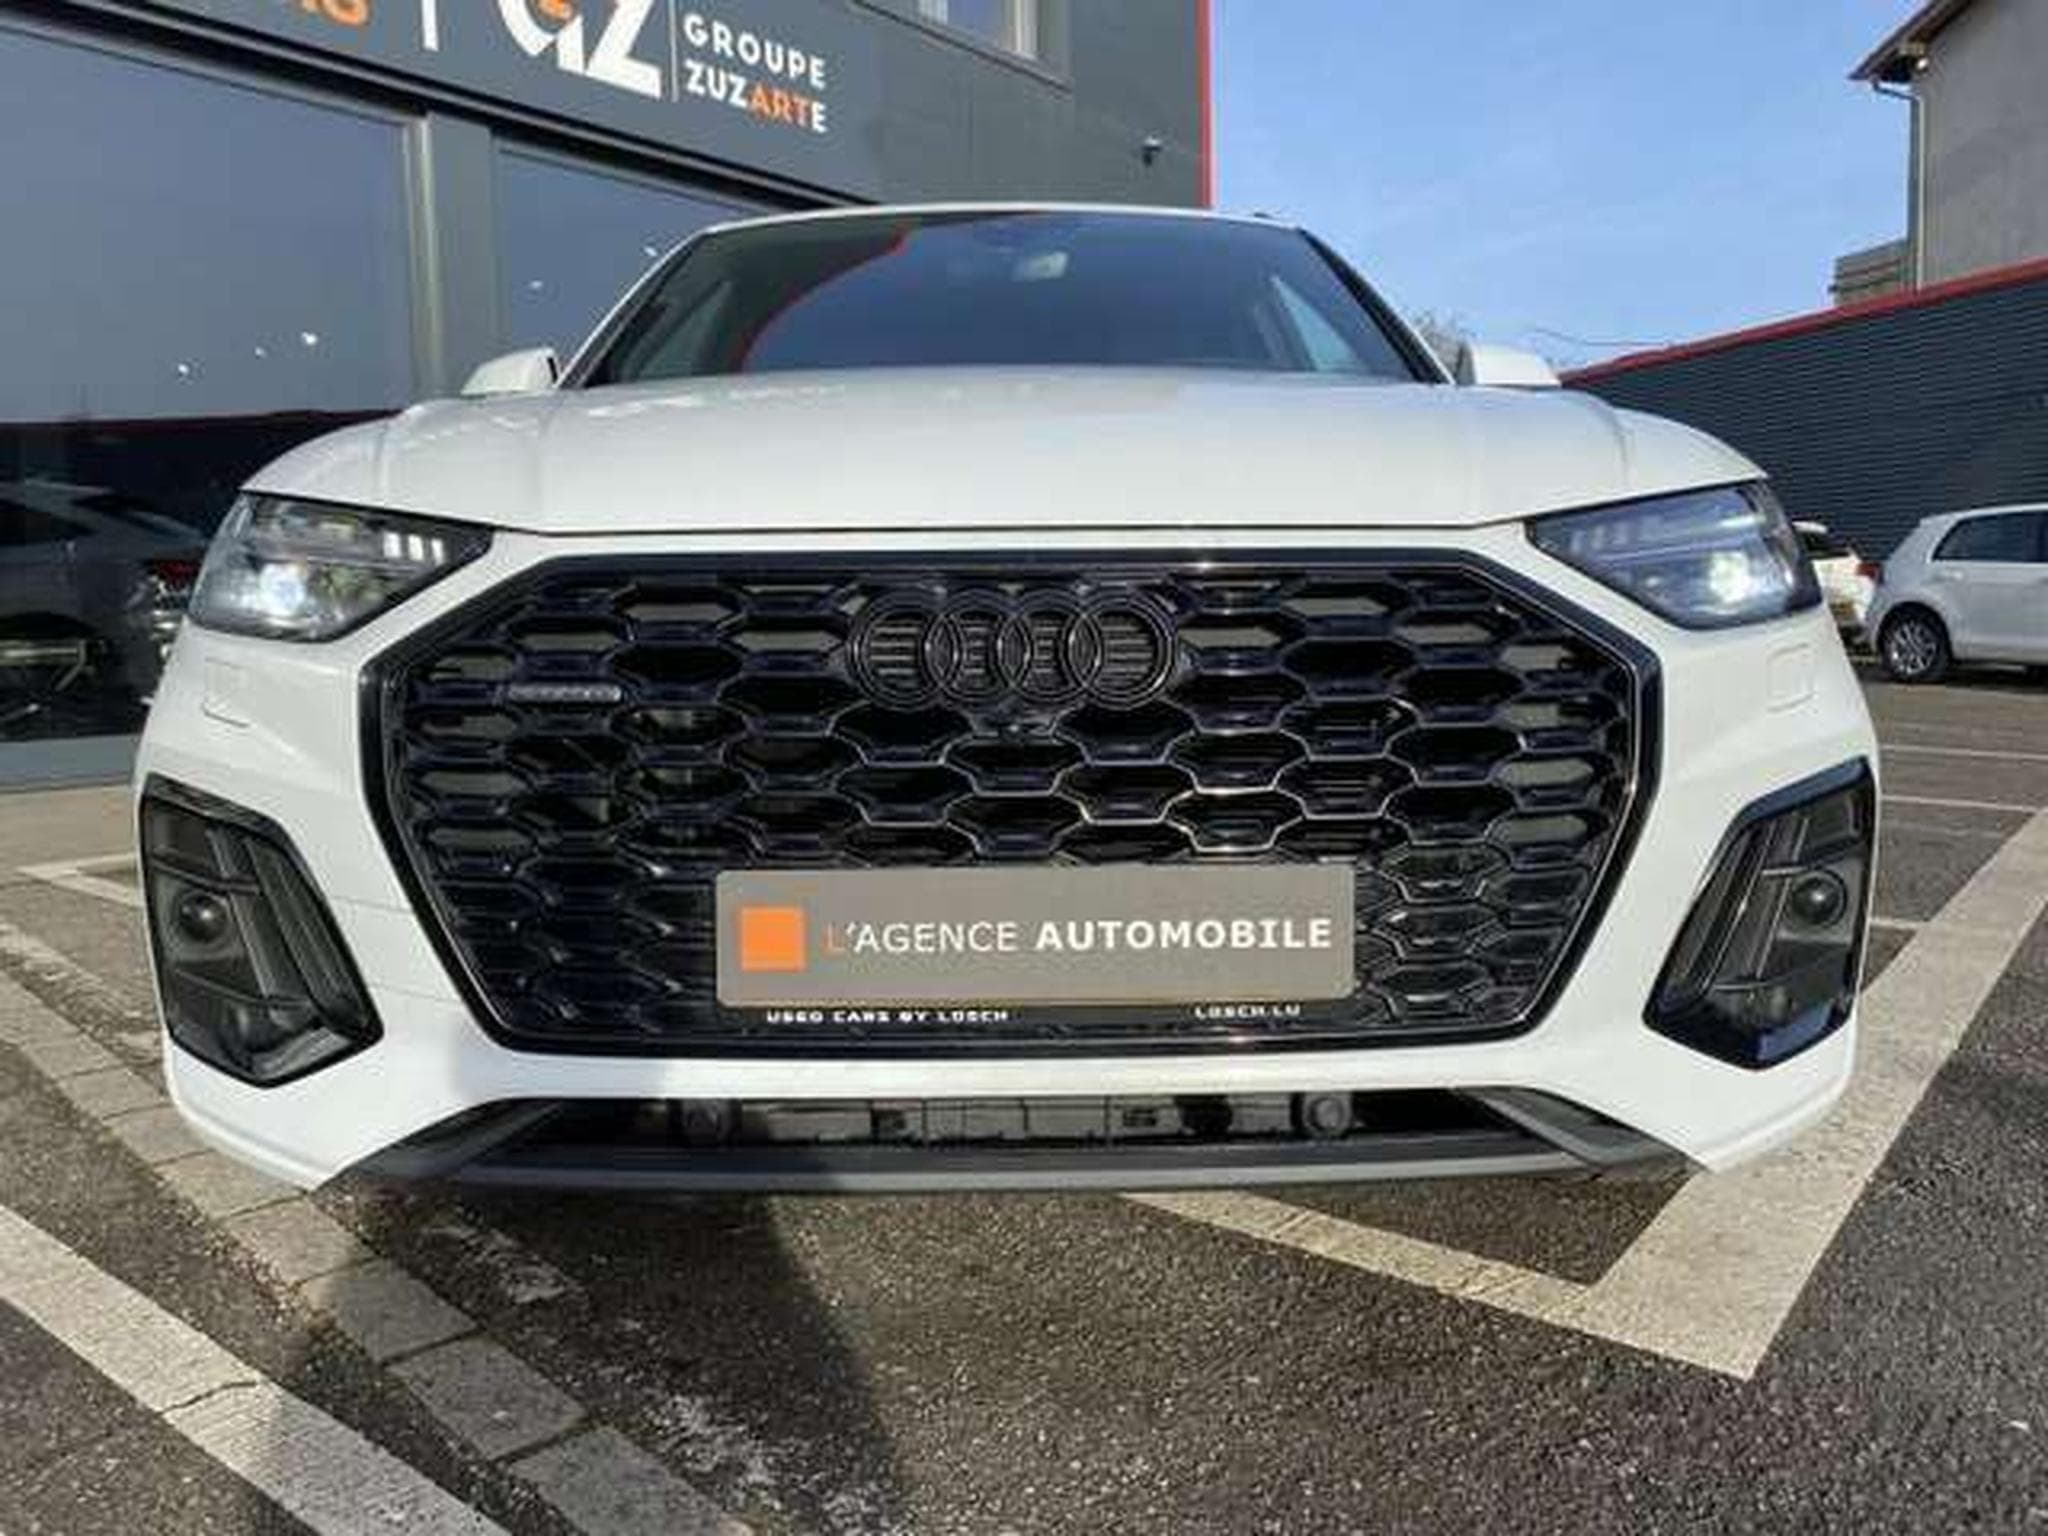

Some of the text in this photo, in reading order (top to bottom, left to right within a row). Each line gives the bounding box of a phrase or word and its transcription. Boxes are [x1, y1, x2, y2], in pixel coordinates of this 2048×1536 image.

[683, 12, 826, 90] GROUPE
[684, 58, 829, 134] ZUZARTE
[1033, 917, 1333, 952] AUTOMOBILE
[765, 1008, 825, 1024] USED
[832, 1008, 891, 1024] CARS
[899, 1008, 929, 1024] BY
